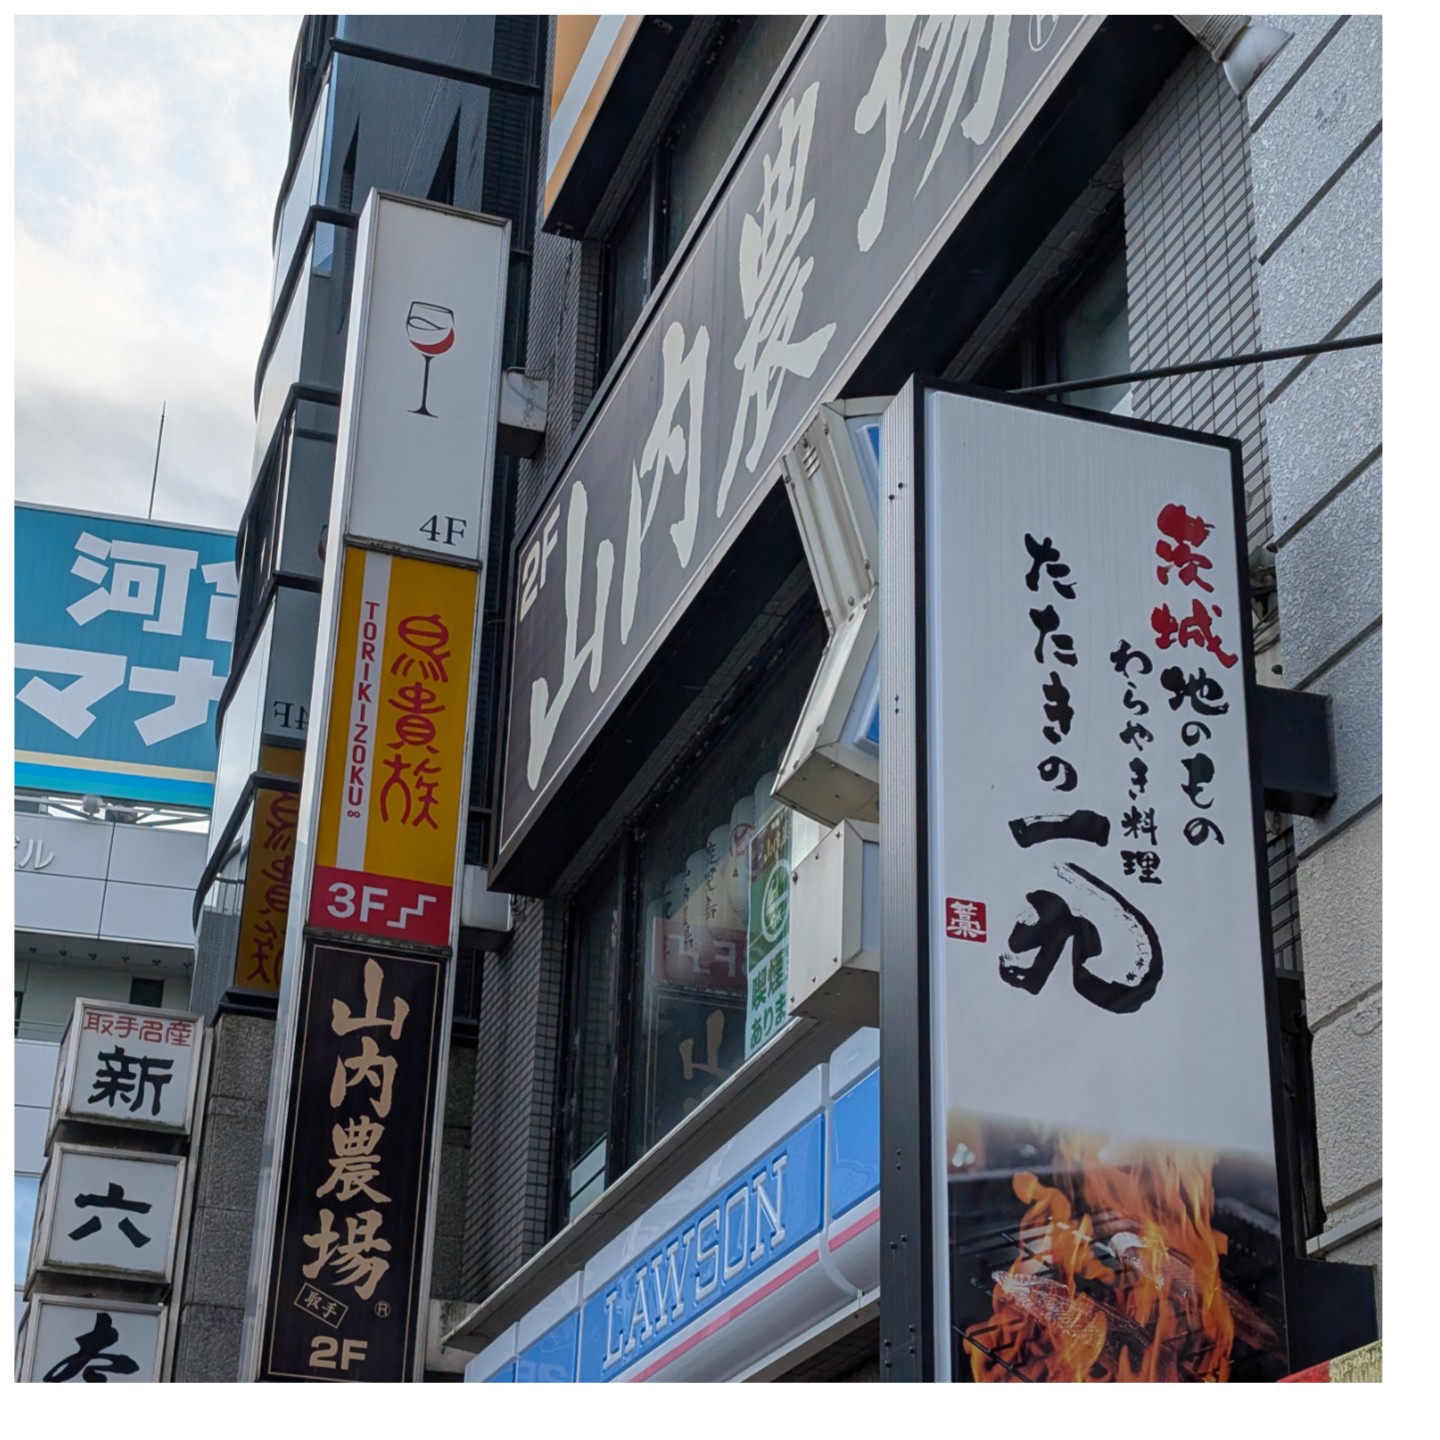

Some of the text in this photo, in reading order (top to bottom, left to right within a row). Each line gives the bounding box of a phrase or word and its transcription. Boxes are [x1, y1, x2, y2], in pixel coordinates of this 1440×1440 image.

[419, 514, 467, 547] 4F
[519, 504, 560, 624] 2F
[379, 613, 452, 830] 鳥貴族
[1151, 503, 1239, 846] 茨城地のもの
[1109, 639, 1163, 885] わらやき料理
[14, 837, 55, 870] ル
[326, 881, 389, 924] 3F
[83, 1011, 193, 1047] 取手名産
[302, 958, 410, 1300] 山内農場
[603, 1150, 788, 1372] LAWSON
[308, 1335, 368, 1371] 2F
